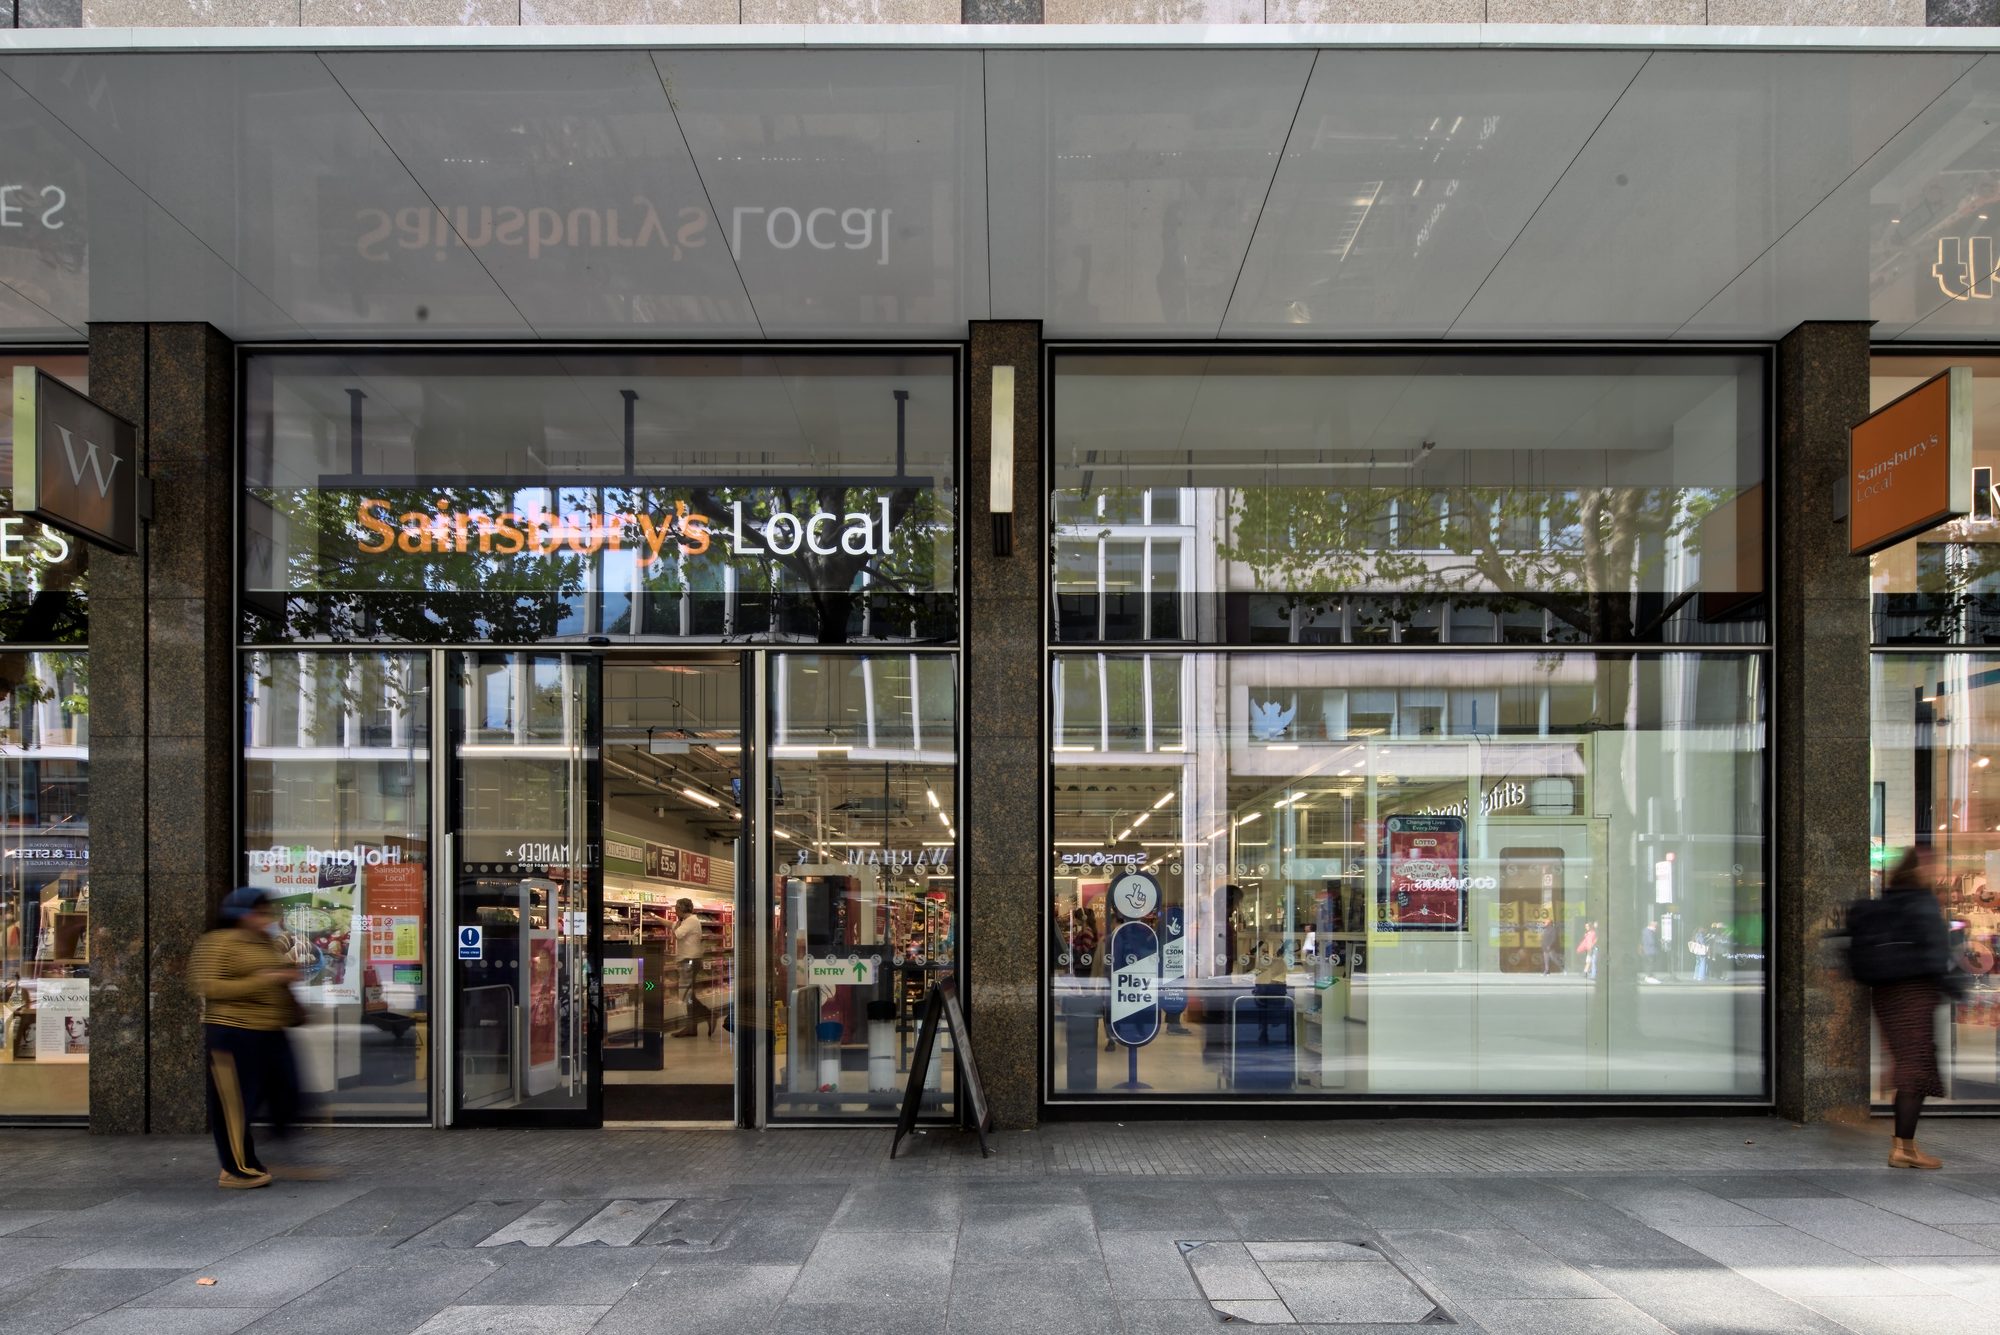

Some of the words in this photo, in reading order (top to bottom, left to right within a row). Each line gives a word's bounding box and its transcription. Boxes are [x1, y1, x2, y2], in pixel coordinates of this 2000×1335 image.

[54, 423, 124, 498] W
[1857, 434, 1939, 485] Sainsbury's
[1857, 472, 1893, 503] Local
[357, 498, 711, 569] Sainsbury's
[733, 497, 894, 556] Local
[606, 841, 630, 858] KITCHEN
[374, 866, 416, 875] Sainsbury's
[274, 875, 293, 884] Deli
[295, 875, 316, 885] deal
[385, 874, 406, 882] Local
[602, 967, 634, 976] ENTRY
[814, 967, 845, 976] ENTRY
[1117, 974, 1152, 991] Play
[42, 994, 65, 1002] SWAN
[1117, 990, 1152, 1003] here
